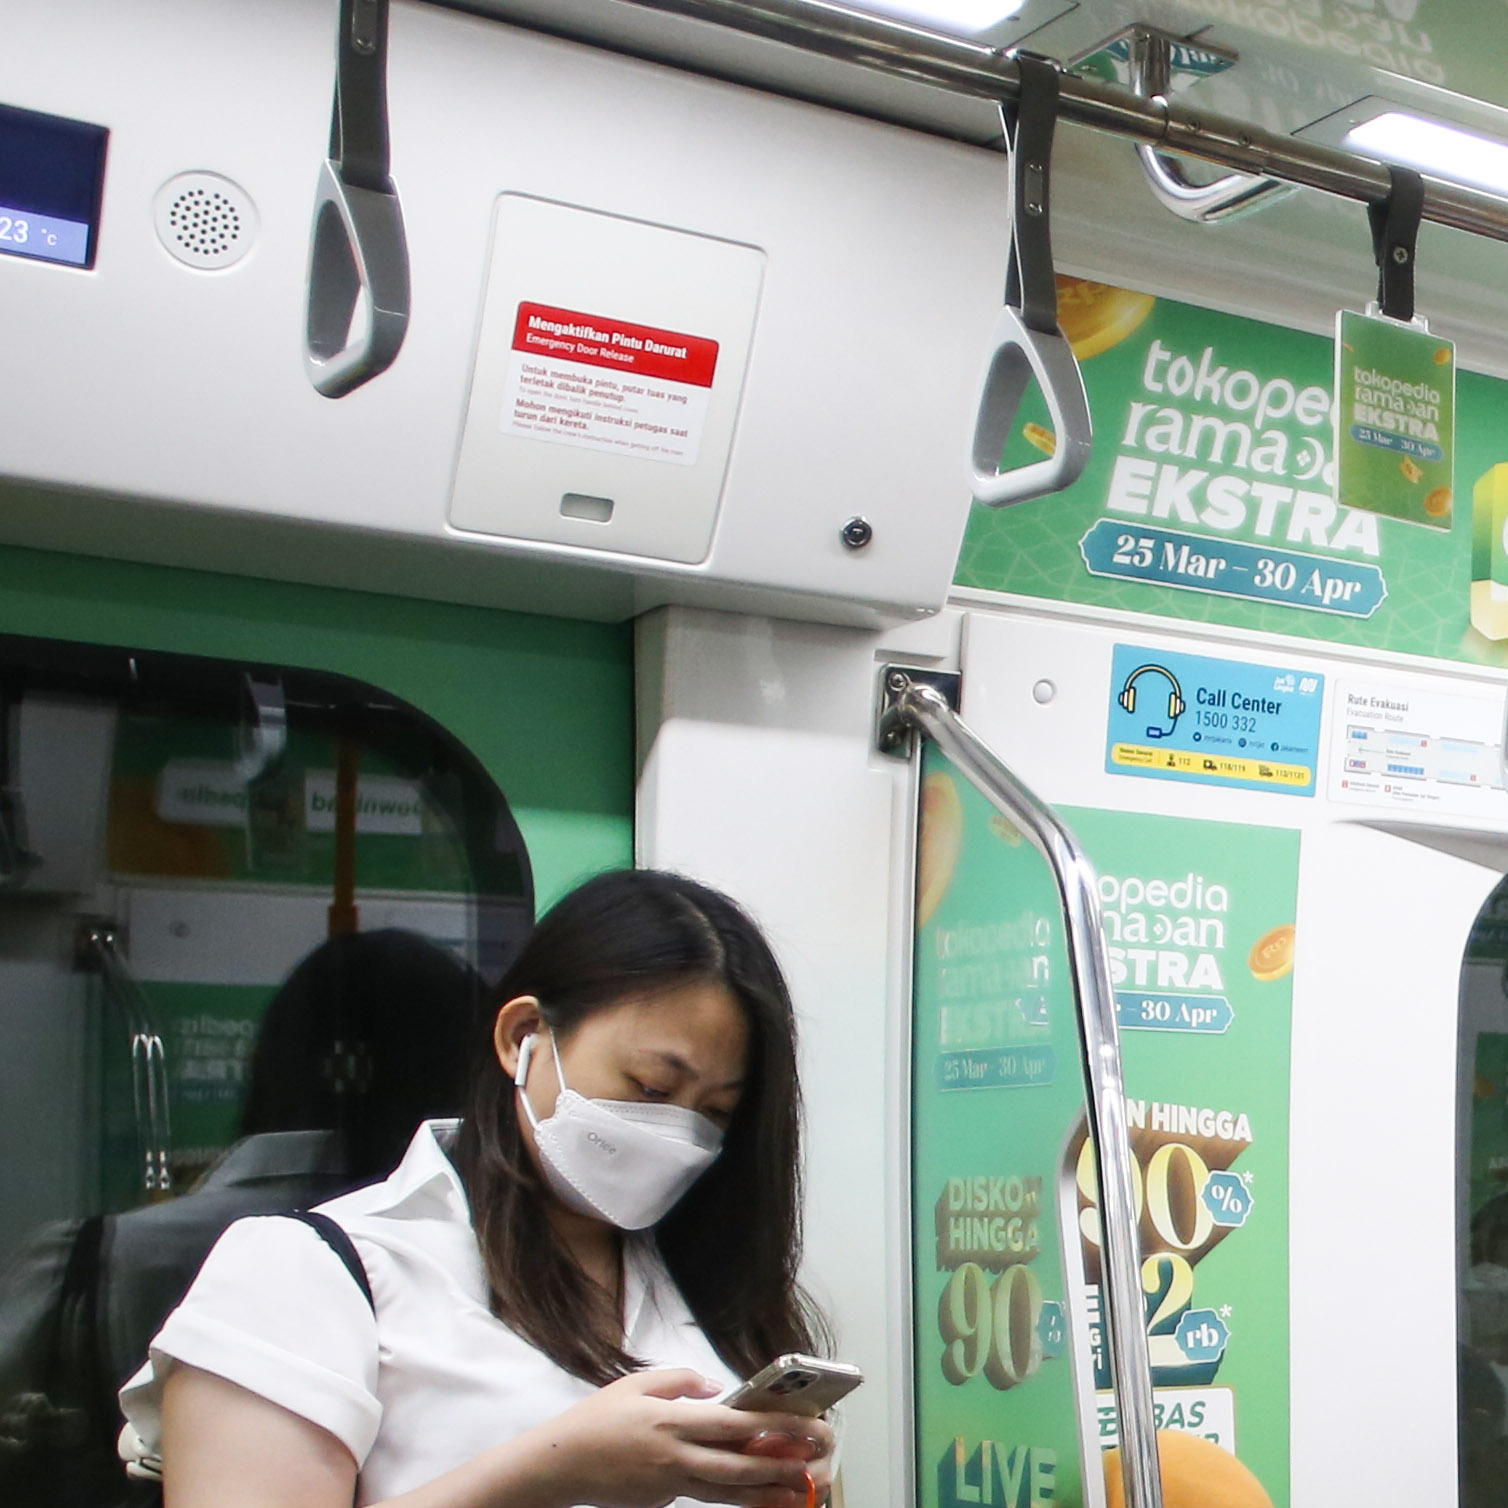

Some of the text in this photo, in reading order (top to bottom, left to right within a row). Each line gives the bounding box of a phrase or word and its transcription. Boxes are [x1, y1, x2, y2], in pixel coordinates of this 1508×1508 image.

[0, 216, 28, 244] 23
[526, 333, 635, 363] Emergency Door Release
[529, 316, 687, 359] Mengaktifkan Pintu Darurat
[520, 375, 555, 390] terletak
[557, 382, 586, 395] dibalik
[522, 364, 547, 377] Untuk
[550, 370, 593, 386] membuka
[622, 383, 644, 397] putar
[647, 388, 664, 400] tuas
[667, 393, 688, 404] yang
[1143, 339, 1335, 430] tokope
[1354, 366, 1441, 404] tokopedia
[514, 409, 589, 431] turun dari kereta.
[516, 398, 688, 438] Mohon mengikuti instruksi petugas saat
[1353, 402, 1440, 442] EKSTRA
[1359, 427, 1371, 439] 25
[1373, 430, 1393, 446] Mar
[1401, 440, 1414, 451] 30
[1106, 454, 1381, 557] EKSTRA
[1112, 534, 1362, 606] 25 Mar 30 Apr
[1196, 687, 1282, 715] Call Center
[1346, 708, 1404, 723] Evacuation Route
[1348, 694, 1409, 712] Rute Evakuasi
[1196, 710, 1256, 733] 1500 332
[1179, 757, 1191, 766] 112
[1099, 872, 1228, 913] opedia
[1110, 947, 1224, 990] STRA
[1141, 1000, 1218, 1027] 30 Apr
[999, 1055, 1016, 1077] 30
[1152, 1103, 1253, 1143] HINGGA
[1210, 1183, 1243, 1215] %
[949, 1216, 1039, 1252] HINGGA
[950, 1262, 1043, 1383] 90
[1186, 1323, 1219, 1348] rb
